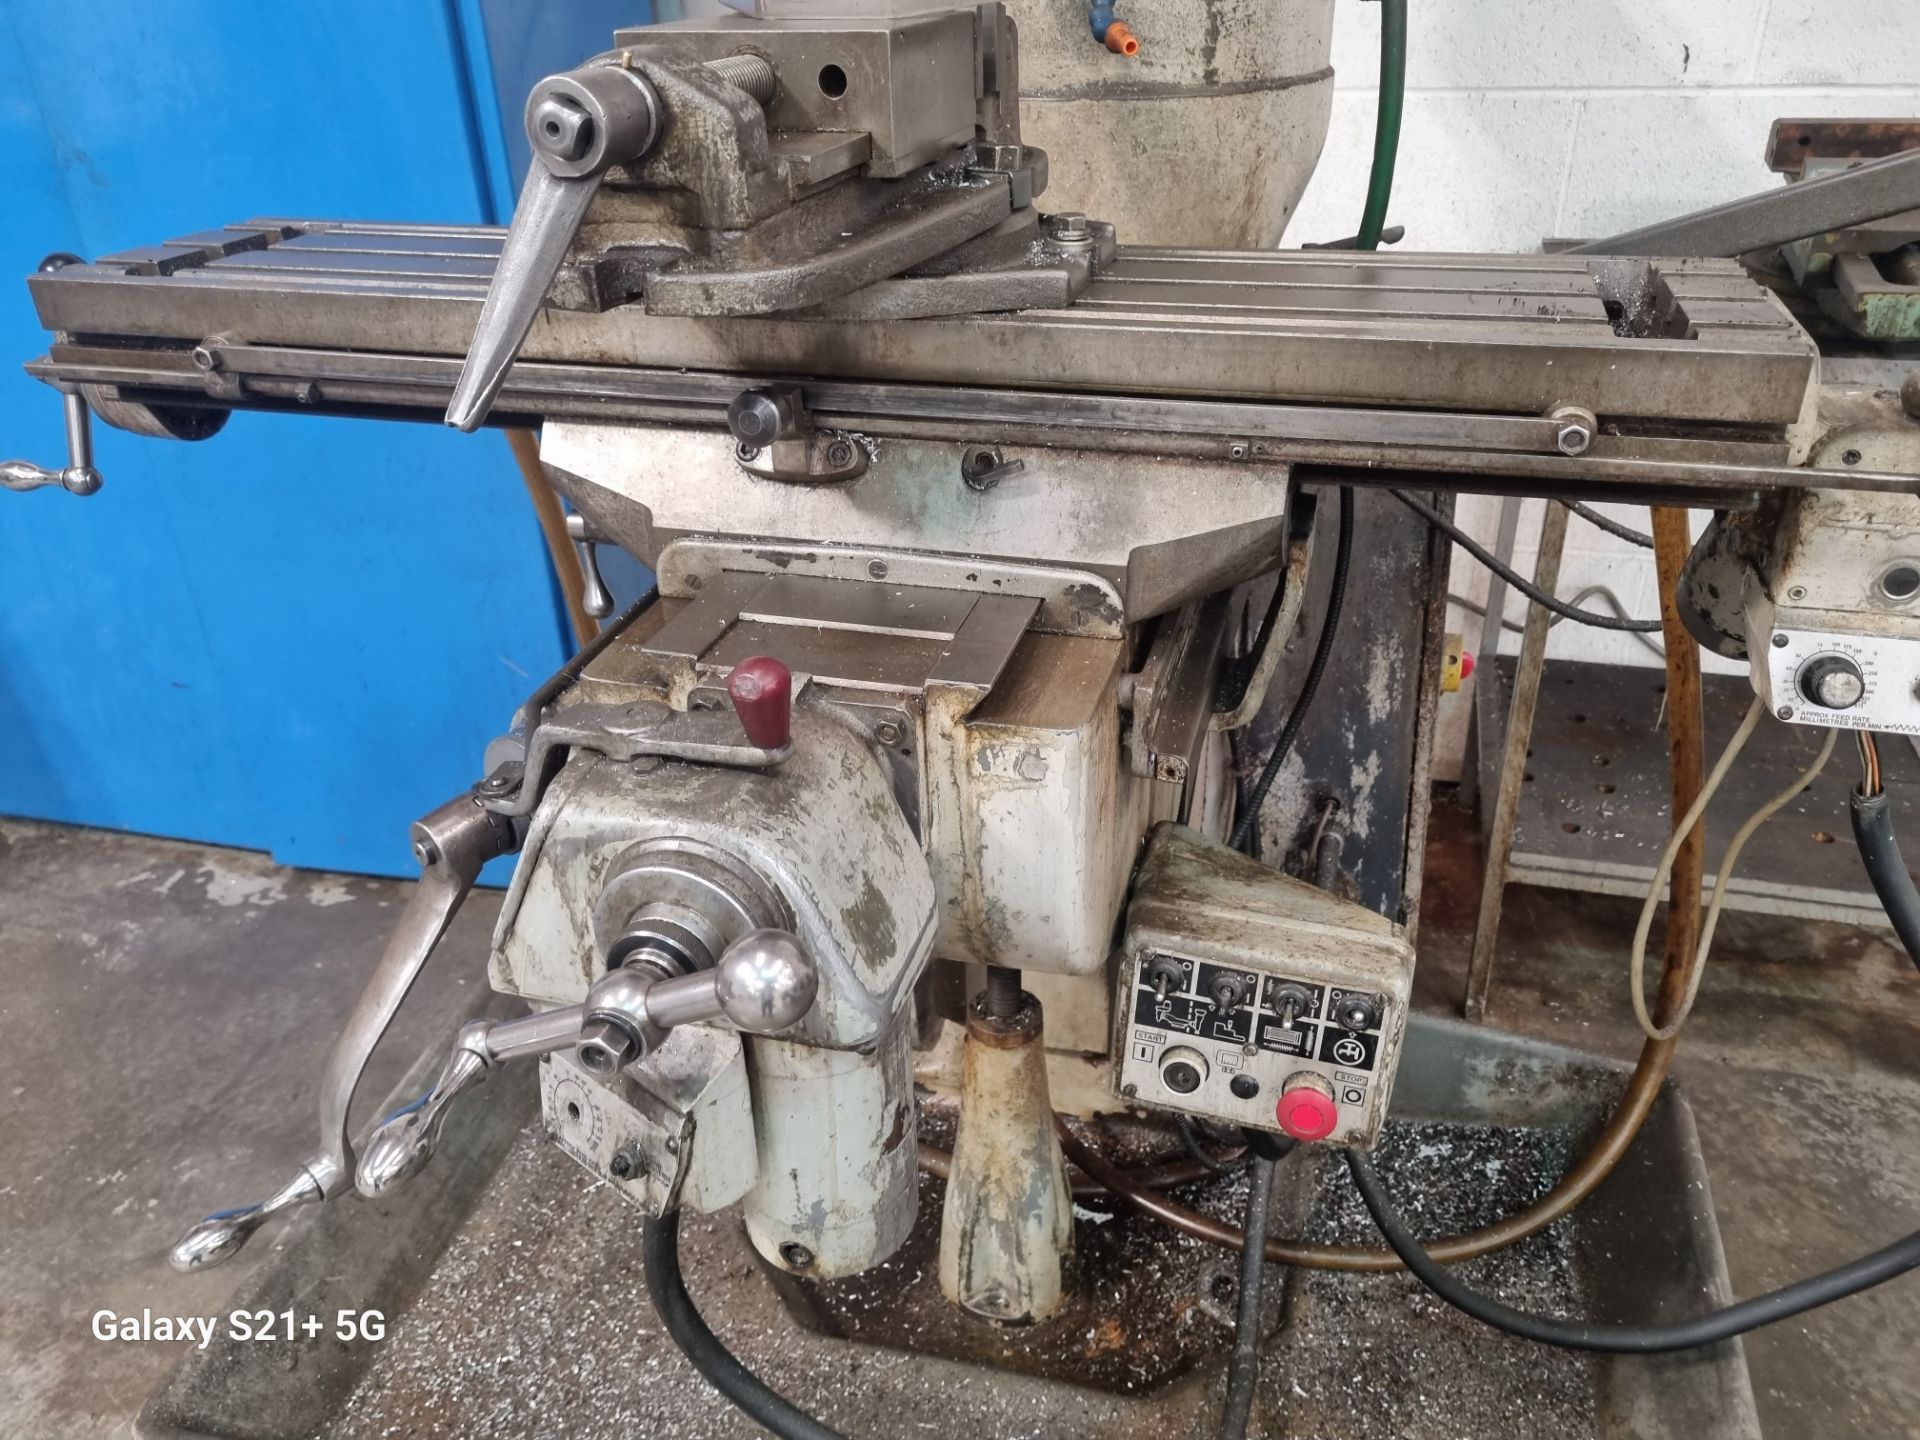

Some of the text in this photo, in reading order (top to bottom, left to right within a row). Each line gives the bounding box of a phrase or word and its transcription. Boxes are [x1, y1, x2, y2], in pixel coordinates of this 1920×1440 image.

[1800, 715, 1848, 726] MILLIMETRES
[1801, 710, 1871, 723] APPROX FEED RATE
[1341, 1073, 1362, 1083] STOP
